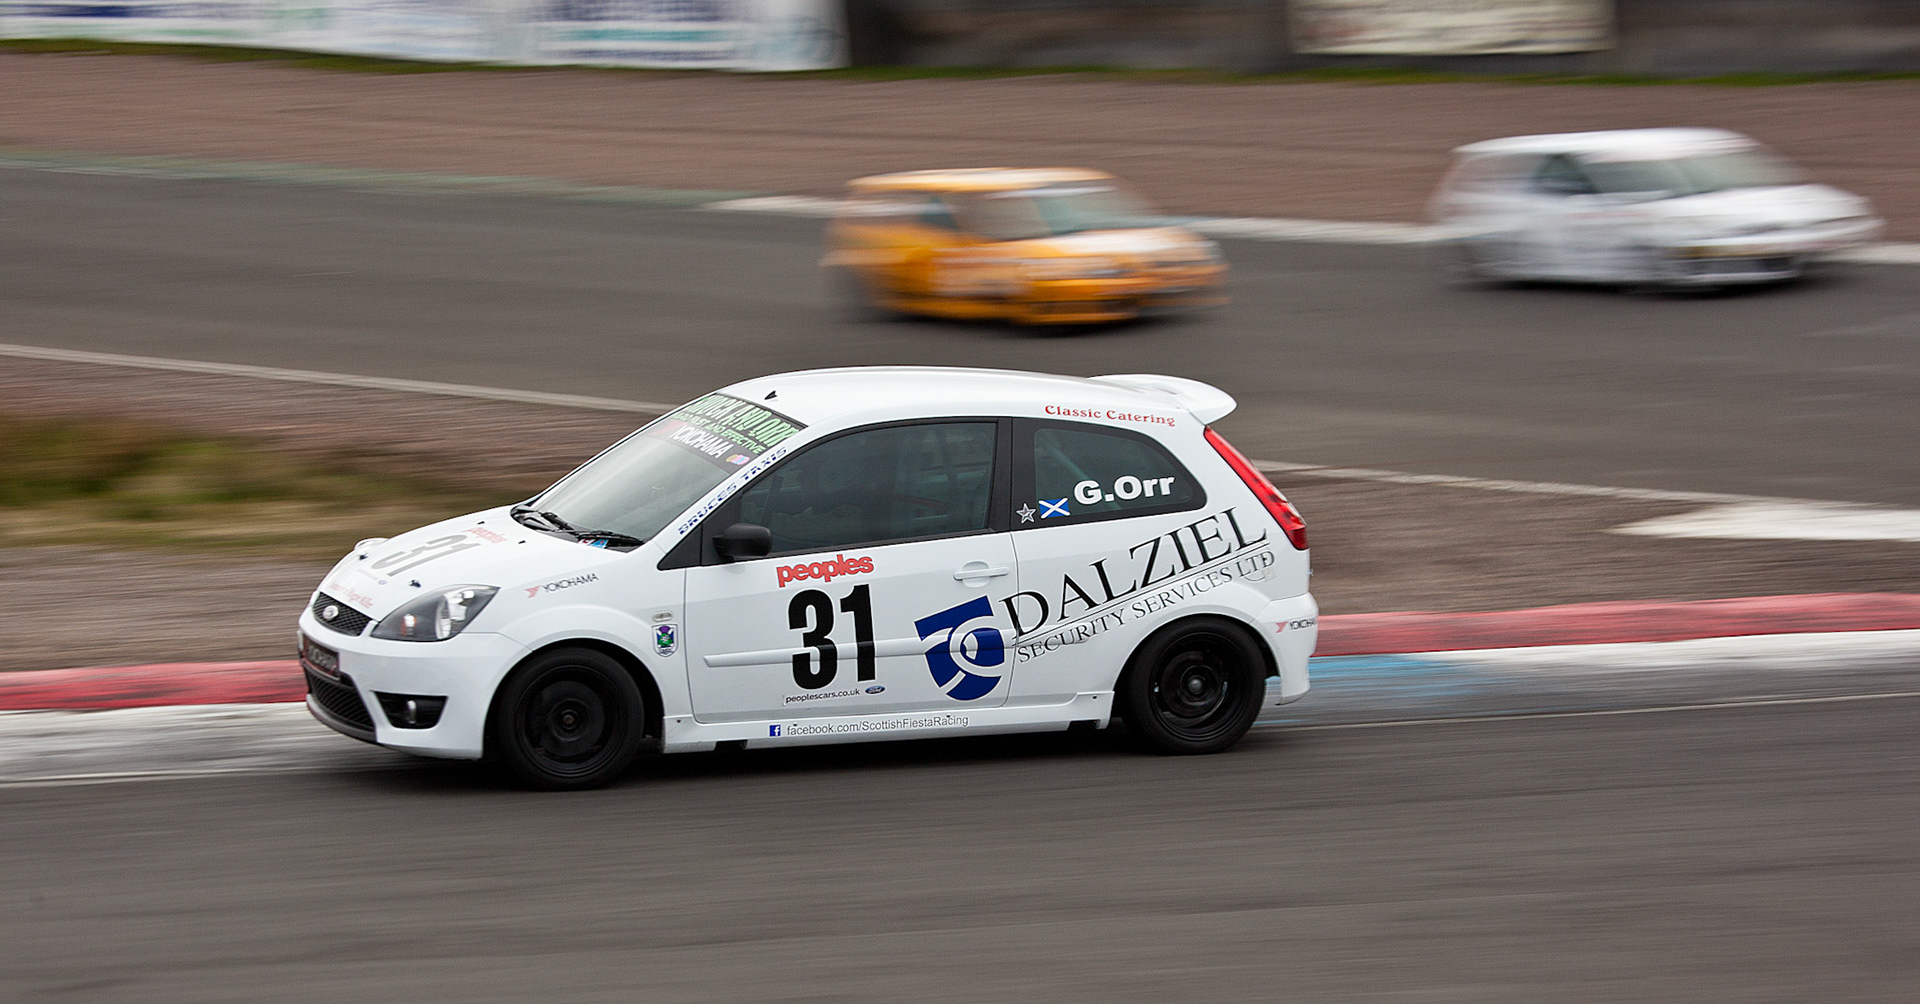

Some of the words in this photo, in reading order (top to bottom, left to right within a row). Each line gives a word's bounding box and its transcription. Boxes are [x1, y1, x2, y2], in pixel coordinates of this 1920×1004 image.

[1045, 404, 1102, 419] Classic
[1106, 410, 1176, 428] Catering
[668, 425, 734, 459] YOKOHAMA
[678, 482, 737, 535] BRUCES
[740, 446, 787, 481] TAXIS
[1073, 475, 1175, 505] G.Orr
[371, 534, 481, 577] 31
[776, 554, 875, 588] peoples
[999, 506, 1267, 639] DALZIEL
[542, 572, 600, 593] YOKOHAMA
[1017, 608, 1126, 664] SECURITY
[1131, 566, 1233, 620] SERVICES
[1235, 550, 1275, 578] LTD
[788, 583, 876, 690] 31
[785, 688, 861, 704] peoplescars.co.uk
[787, 714, 970, 736] facebook.com/ScottishFiestaRacing
